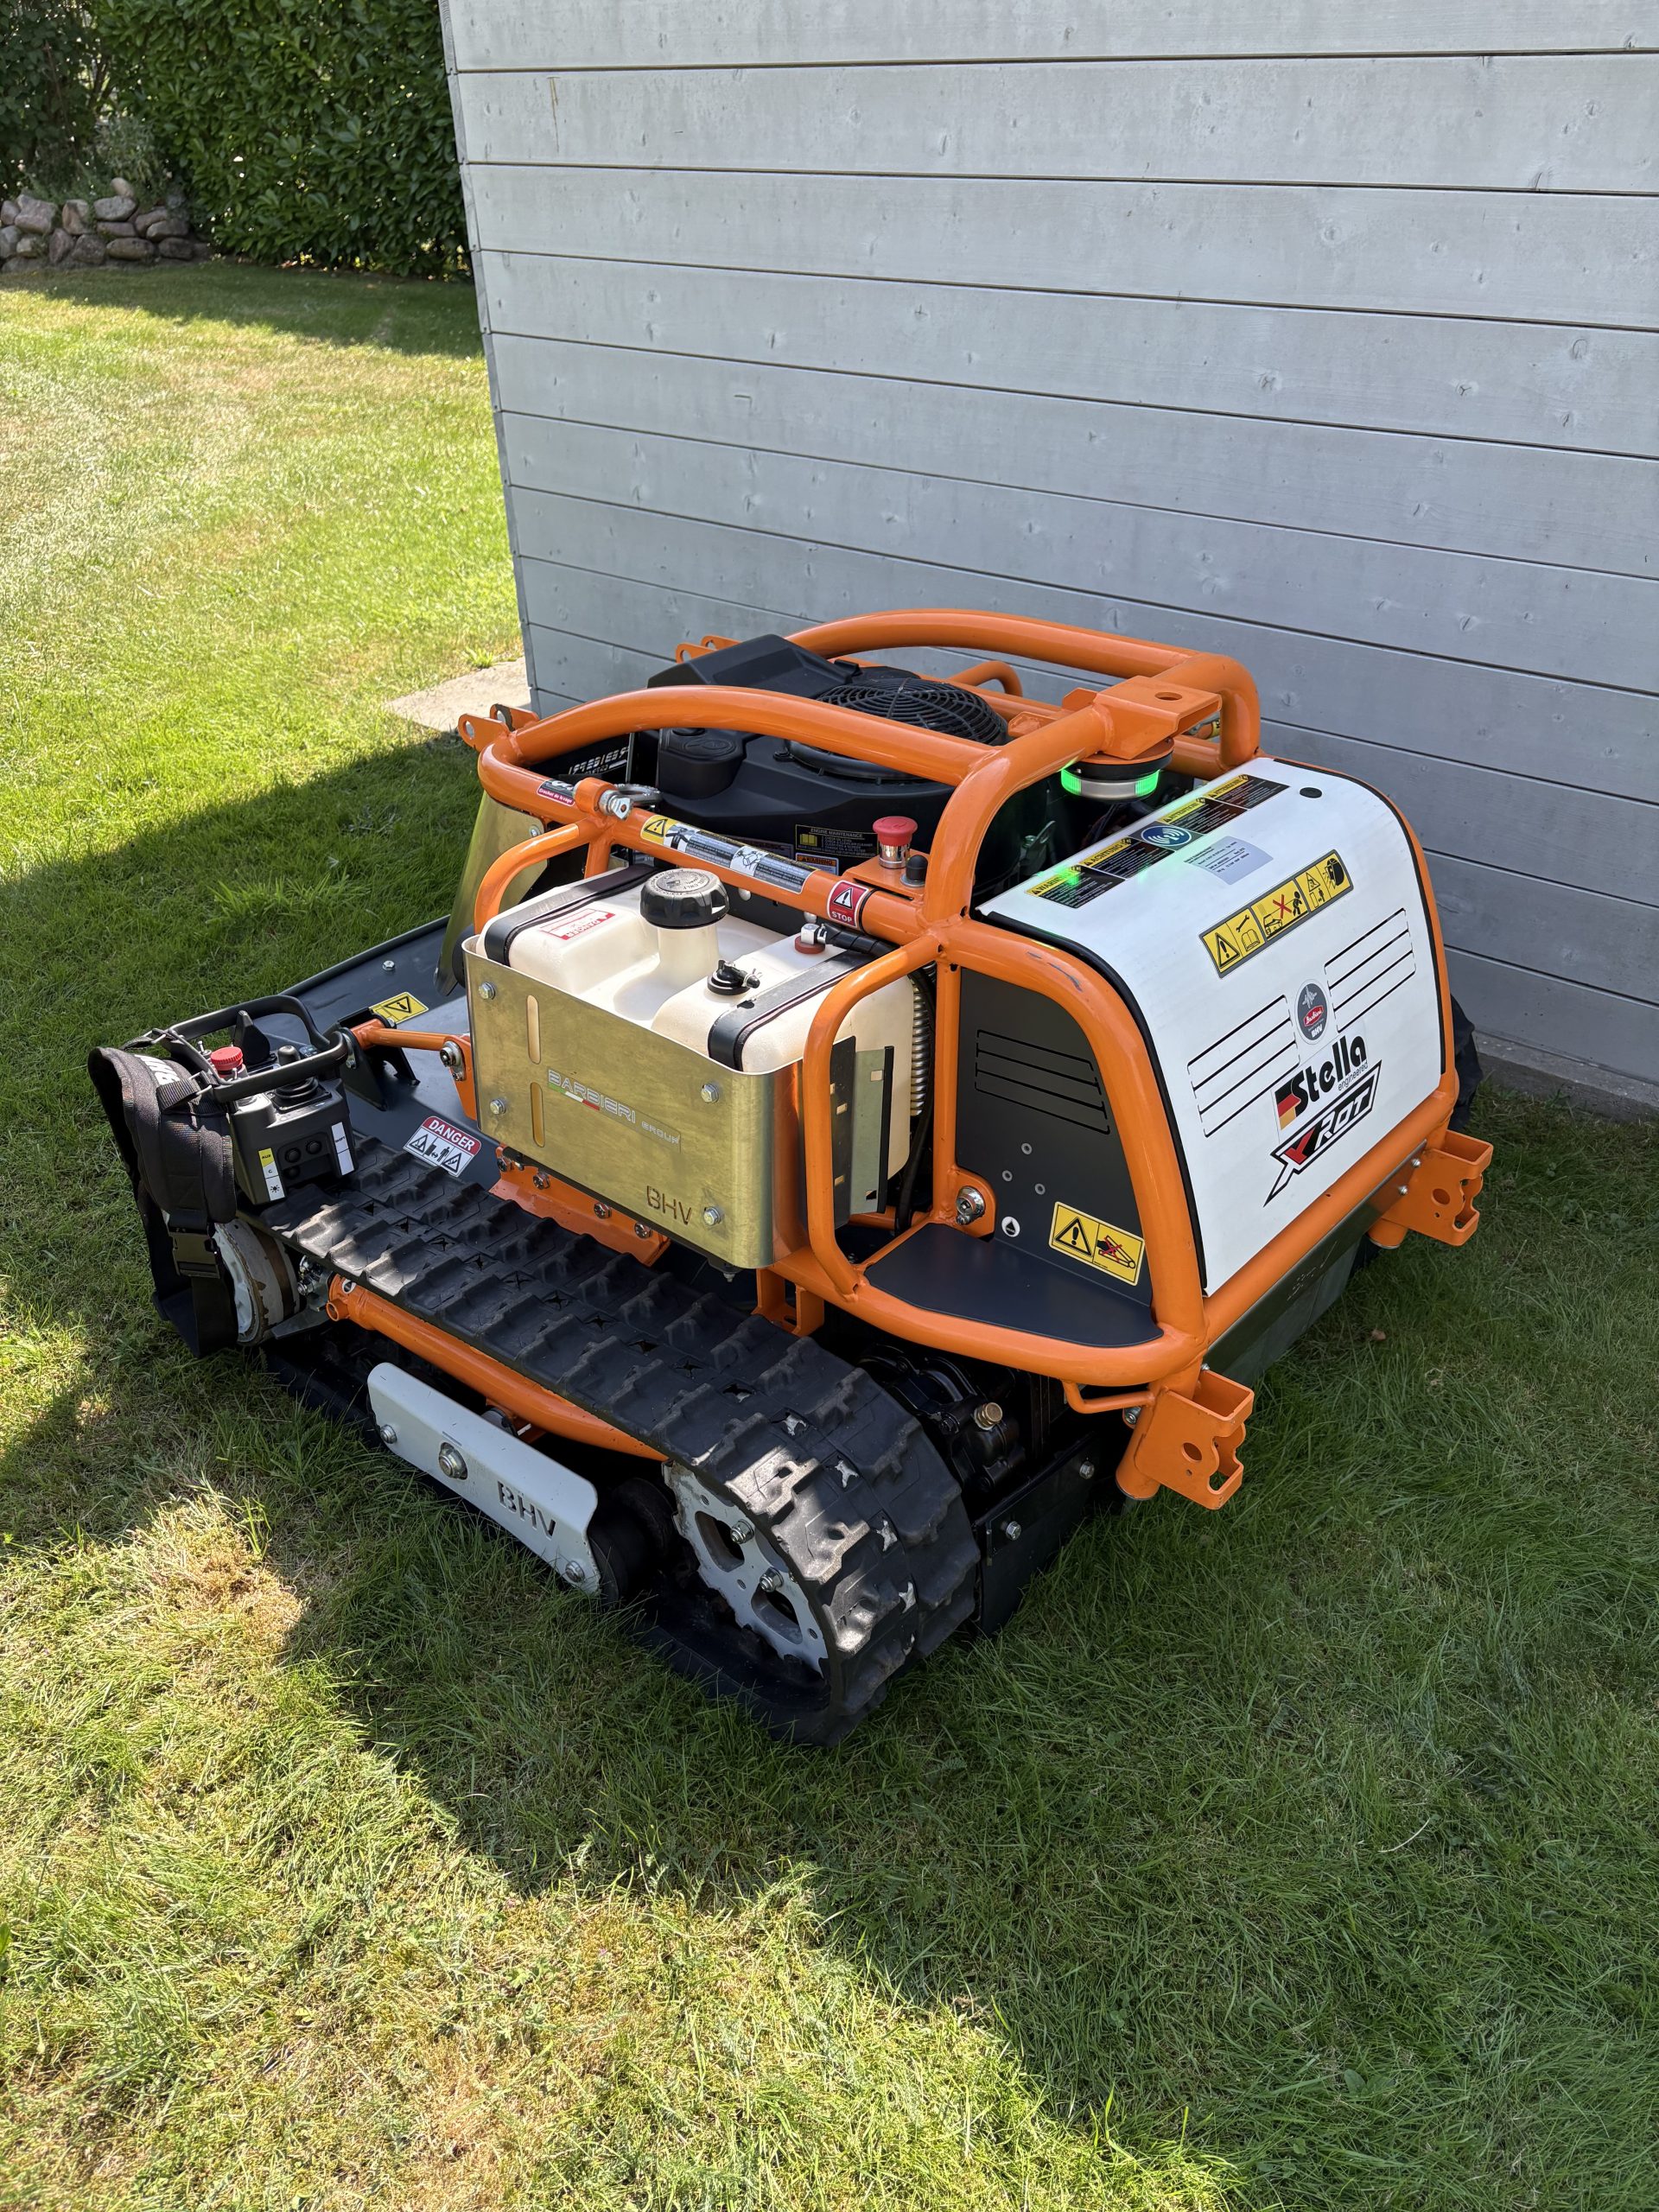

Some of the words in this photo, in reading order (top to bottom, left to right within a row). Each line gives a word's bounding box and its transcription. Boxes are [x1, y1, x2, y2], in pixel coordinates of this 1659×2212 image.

[831, 911, 853, 923] STOP
[1311, 1023, 1323, 1038] BHV
[1291, 1035, 1367, 1118] Stella
[1338, 1059, 1369, 1091] engineered
[548, 1068, 636, 1124] BARBIERI
[641, 1121, 679, 1145] GROUP
[428, 1119, 475, 1151] DANGER
[646, 1185, 692, 1225] BHV
[497, 1480, 556, 1541] BHV
